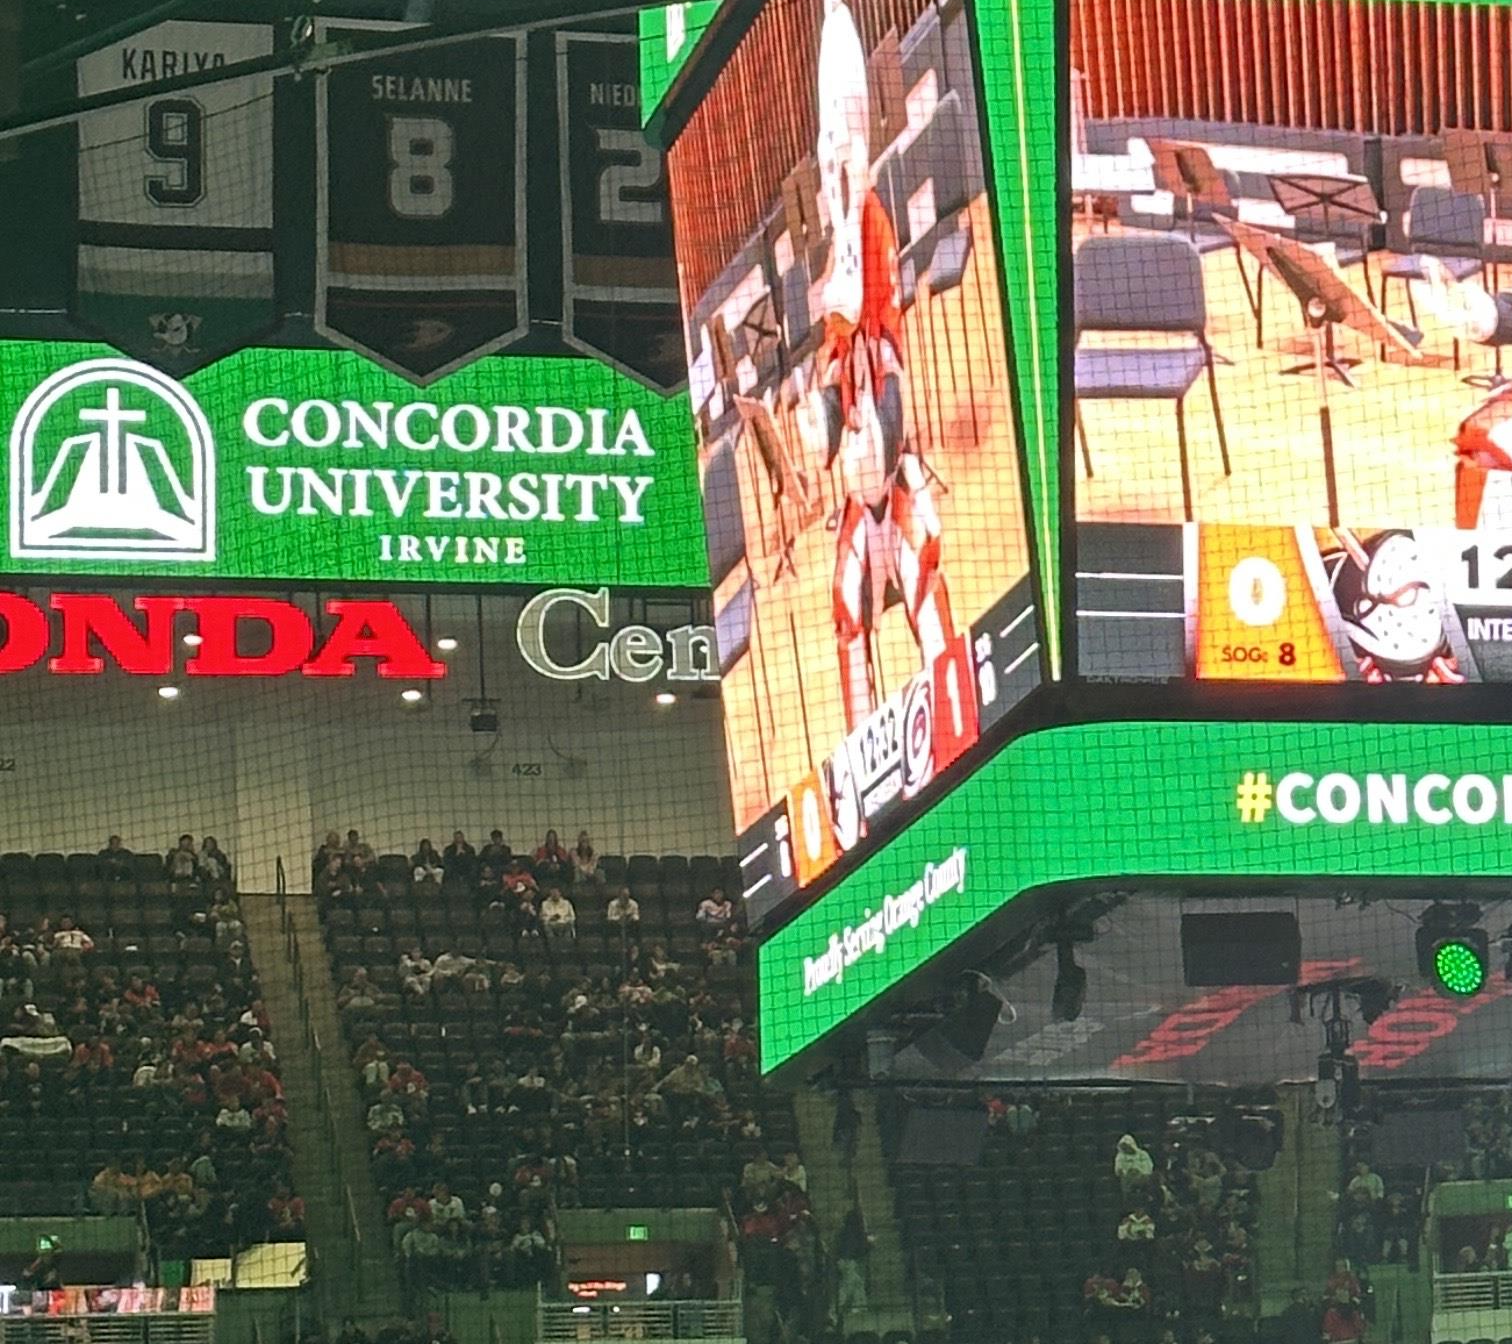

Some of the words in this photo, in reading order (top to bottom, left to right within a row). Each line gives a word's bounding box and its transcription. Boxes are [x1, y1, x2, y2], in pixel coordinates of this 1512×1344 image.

[372, 74, 472, 104] SELANNE
[144, 95, 206, 208] 9
[388, 117, 454, 219] 8
[243, 398, 655, 456] CONCORDIA
[245, 465, 654, 524] UNIVERSITY
[380, 534, 527, 564] IRVINE
[1228, 556, 1288, 627] 0
[517, 587, 720, 682] Cen
[1278, 642, 1297, 666] 8
[512, 762, 542, 778] 423
[859, 708, 899, 776] 12:32
[803, 934, 845, 997] Proudly
